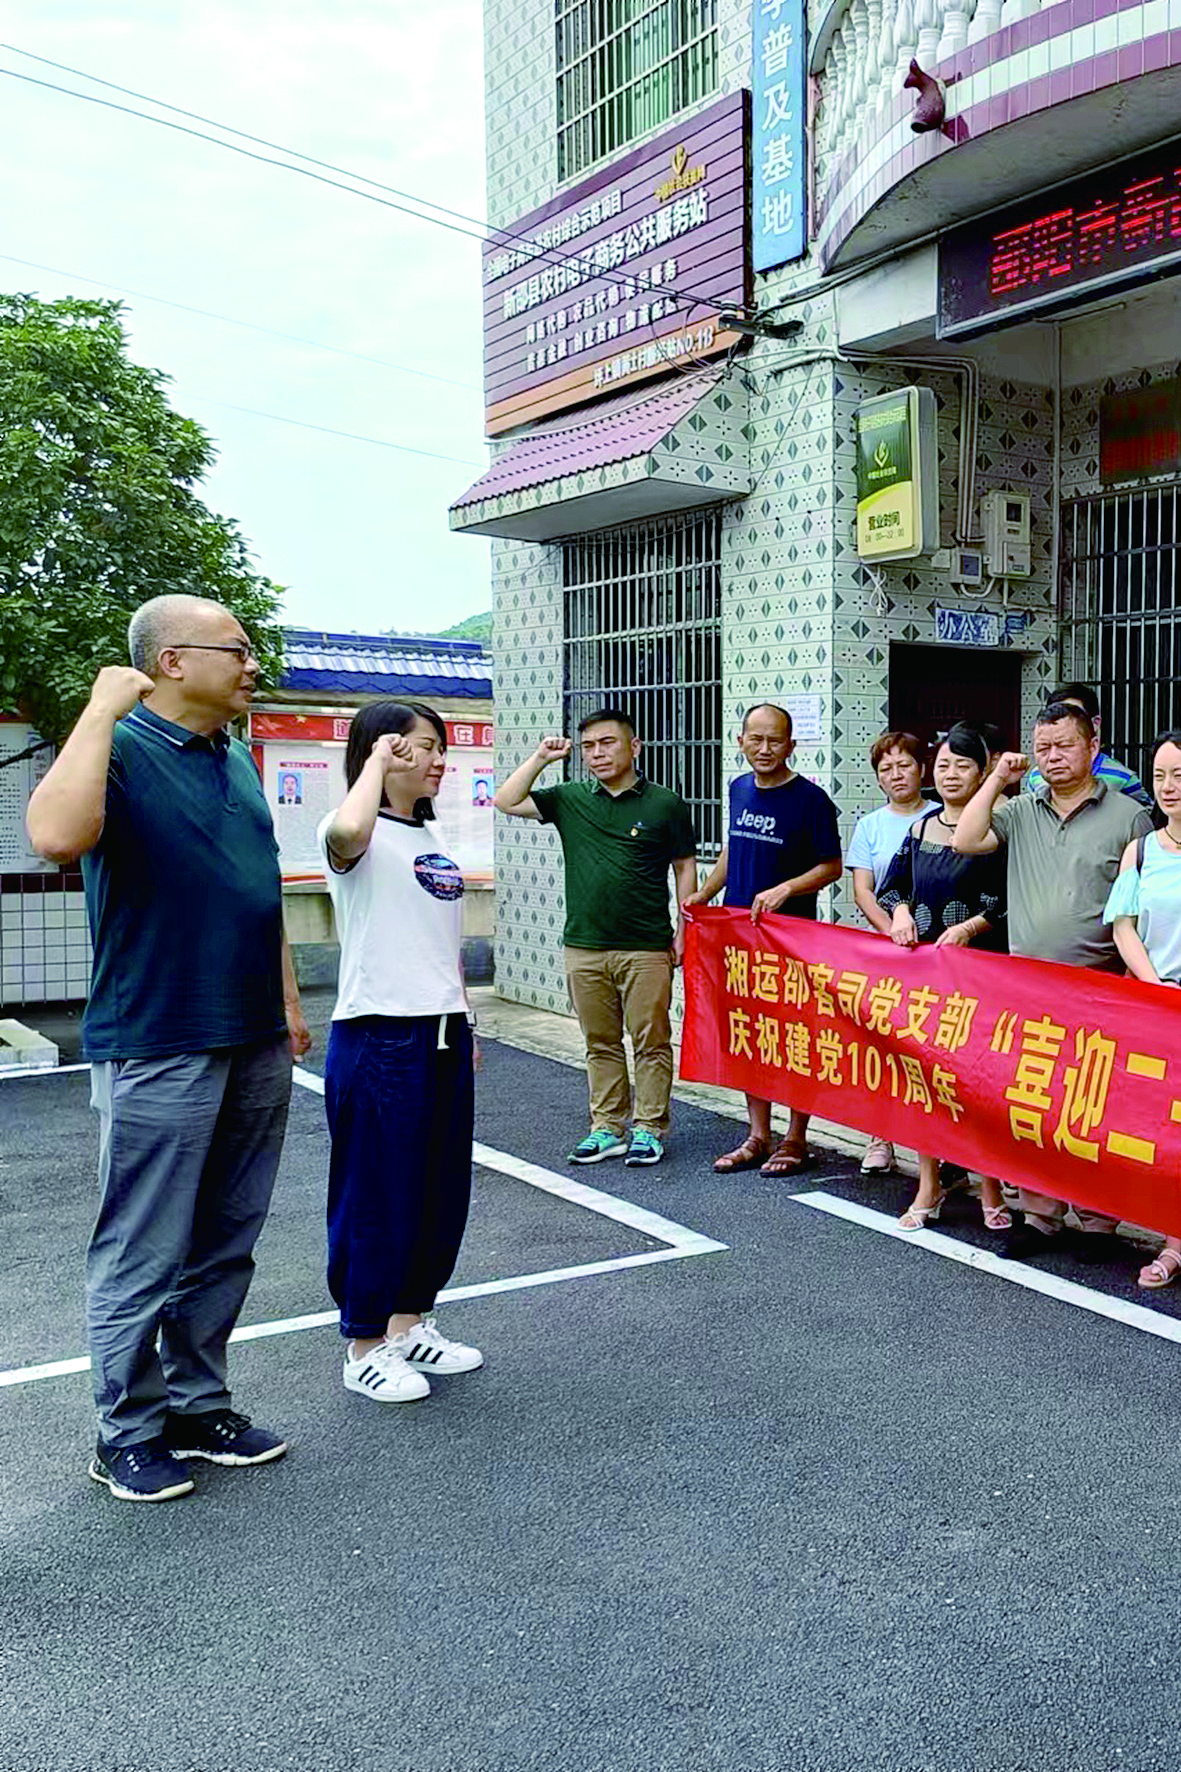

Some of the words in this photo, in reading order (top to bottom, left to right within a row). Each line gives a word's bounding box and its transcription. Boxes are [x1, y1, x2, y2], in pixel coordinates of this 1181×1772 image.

[868, 510, 900, 531] 营业时间
[723, 946, 979, 1054] 湘运邵客司党支部
[727, 1007, 964, 1122] 庆祝建党101周年
